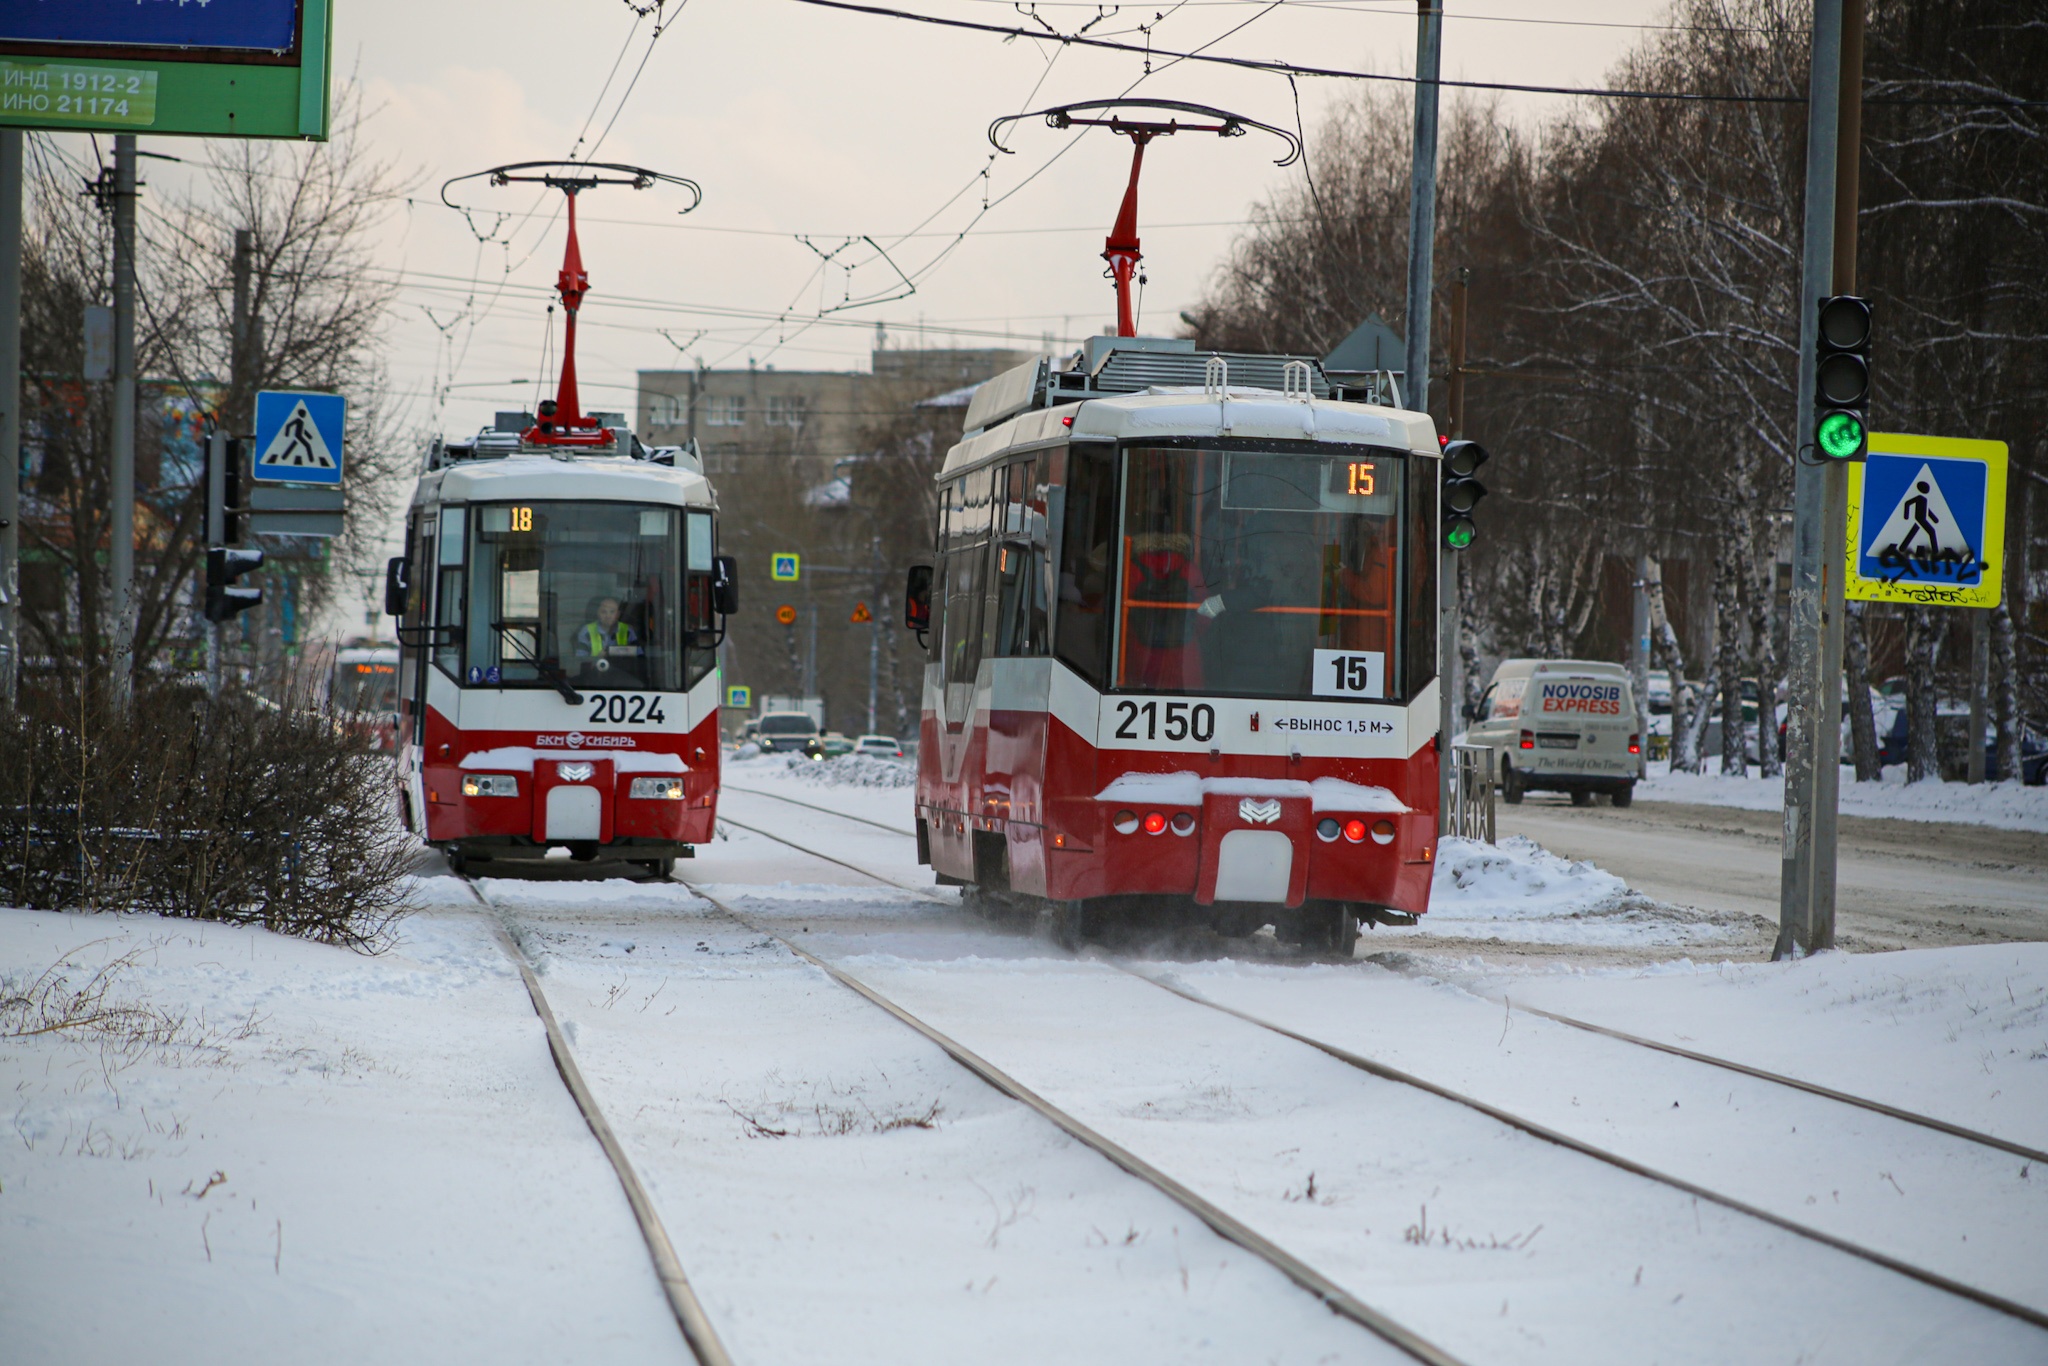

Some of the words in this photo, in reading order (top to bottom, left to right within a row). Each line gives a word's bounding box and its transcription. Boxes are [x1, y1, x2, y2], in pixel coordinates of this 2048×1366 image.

[4, 69, 49, 91] ИНД
[60, 72, 141, 95] 1912-2
[3, 92, 49, 112] ИНО
[56, 94, 129, 117] 21174
[1348, 463, 1374, 495] 15
[511, 507, 533, 531] 18
[1331, 656, 1367, 691] 15
[1542, 684, 1620, 700] NOVOSIB
[589, 694, 665, 724] 2024
[1543, 698, 1620, 715] EXPRESS
[1115, 700, 1215, 742] 2150
[1289, 718, 1342, 732] ВЫНОС
[1347, 720, 1366, 734] 1,5
[1370, 721, 1381, 733] М
[536, 735, 565, 746] БКМ
[585, 735, 636, 747] СИБИРЬ
[1538, 757, 1556, 768] The
[1557, 758, 1585, 769] World
[1587, 759, 1602, 769] On
[1603, 760, 1626, 770] Time
